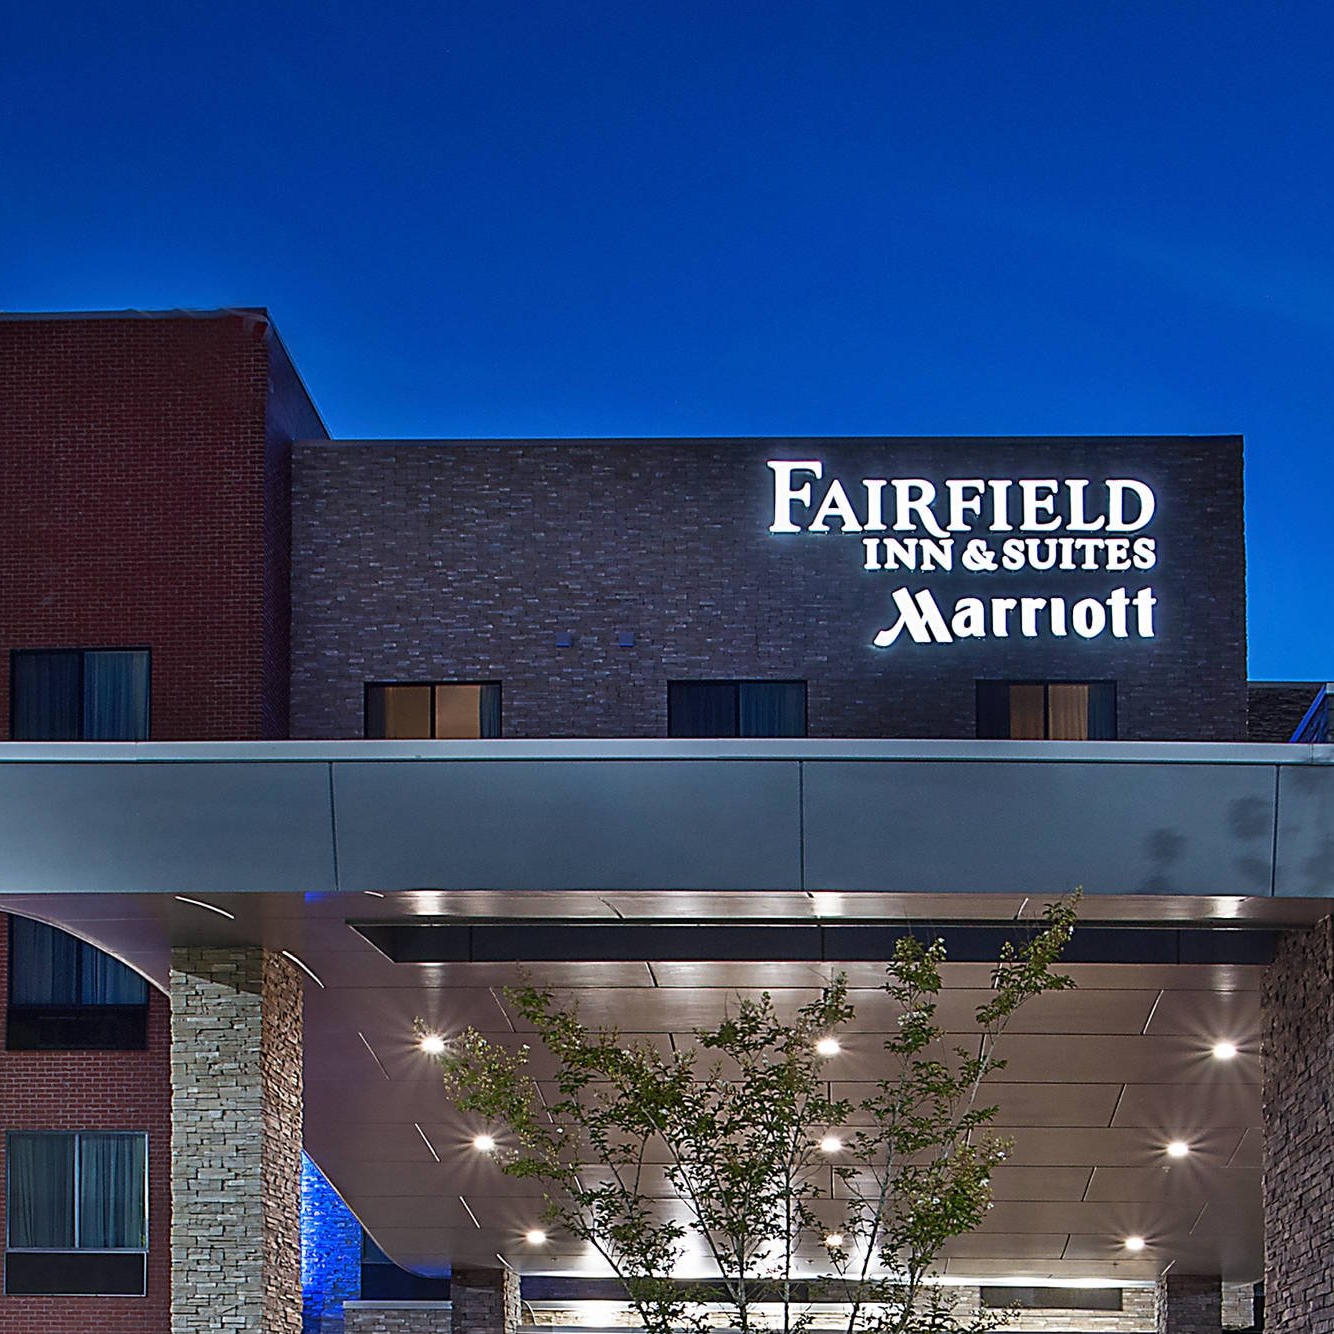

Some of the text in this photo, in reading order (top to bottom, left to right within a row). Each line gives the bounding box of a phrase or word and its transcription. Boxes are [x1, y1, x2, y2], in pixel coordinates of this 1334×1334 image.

[767, 460, 1156, 539] FAIRFIELD
[862, 537, 1157, 571] INN & SUITES
[873, 586, 1157, 647] Marriott
